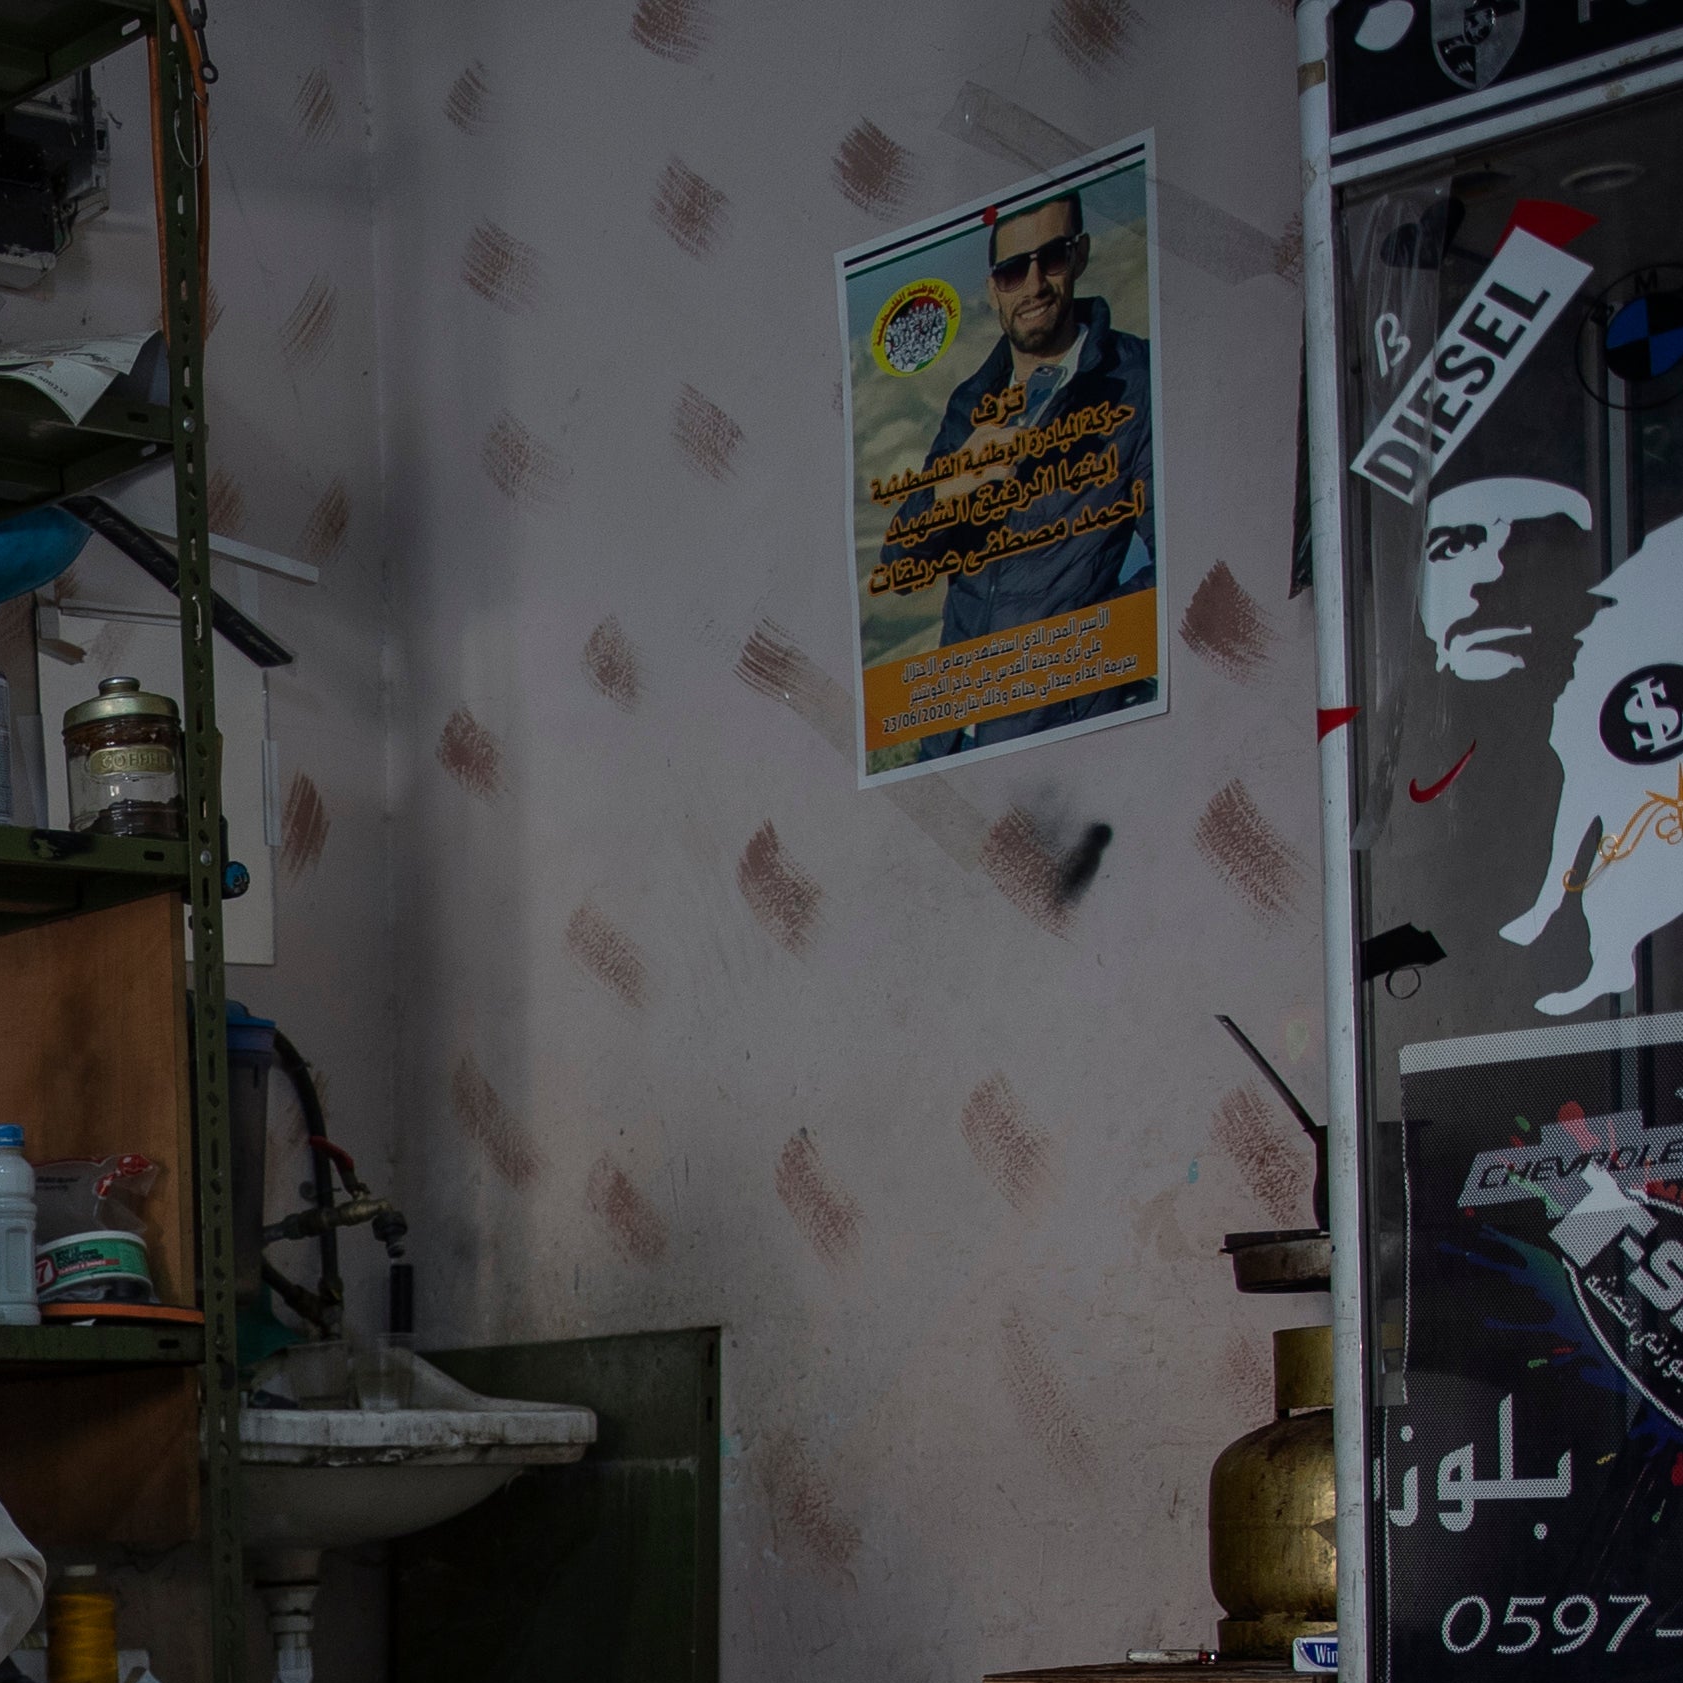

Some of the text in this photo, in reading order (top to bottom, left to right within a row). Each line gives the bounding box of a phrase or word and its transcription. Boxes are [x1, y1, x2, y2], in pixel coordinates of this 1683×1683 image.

[1363, 281, 1551, 498] DIESEL
[972, 385, 1027, 425] تزف
[871, 400, 1134, 506] حركة المبادرة الوطنية الفلسطينية
[884, 444, 1119, 546] إبنها الرفيق الشهيد
[869, 480, 1145, 594] أحمد مصطفى عريقات
[1047, 617, 1076, 646] المحرر
[1078, 607, 1110, 637] الأسير
[975, 634, 1020, 662] استشهد
[1022, 627, 1044, 652] الذي
[1083, 638, 1102, 660] على
[938, 649, 973, 674] برصاص
[1032, 650, 1062, 670] مدينة
[1064, 644, 1081, 665] ثرى
[976, 670, 992, 690] على
[994, 656, 1029, 682] القدس
[1074, 662, 1102, 686] إعدام
[951, 676, 972, 696] حاجز
[982, 686, 1008, 708] وذلك
[1040, 670, 1072, 700] ميداني
[883, 702, 952, 734] 23/06/2020
[953, 692, 981, 720] بتاريخ
